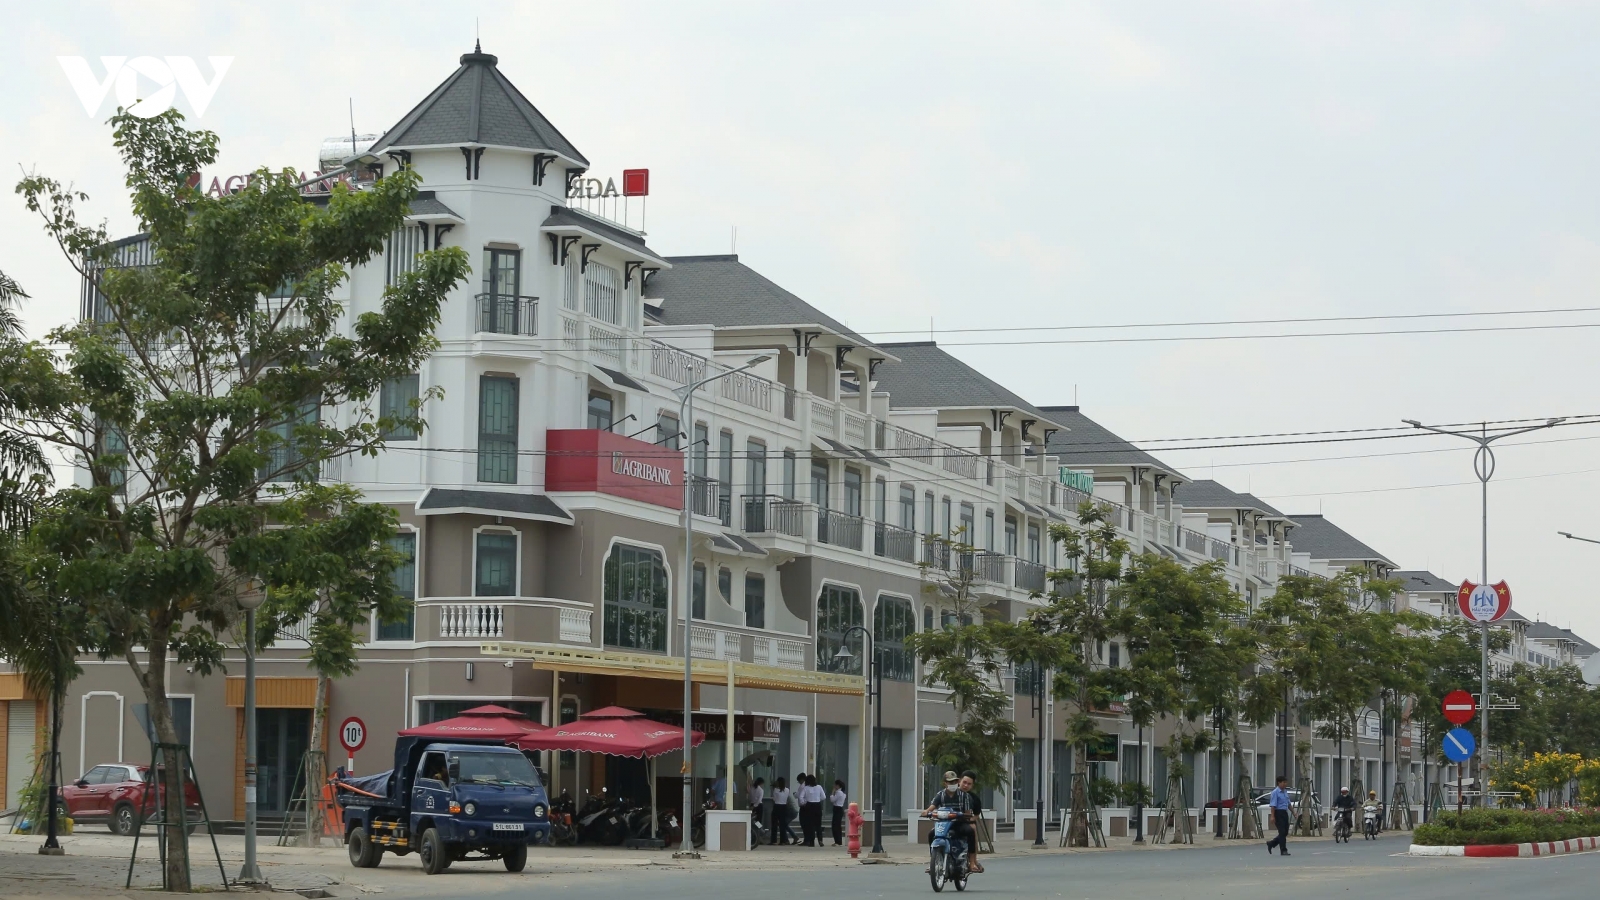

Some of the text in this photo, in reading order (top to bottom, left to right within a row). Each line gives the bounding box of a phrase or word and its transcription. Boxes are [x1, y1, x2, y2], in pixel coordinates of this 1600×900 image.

[207, 170, 358, 198] AGANK
[623, 459, 672, 486] AGRIBANK
[568, 731, 617, 739] AGRIBANK
[766, 718, 781, 733] CDM
